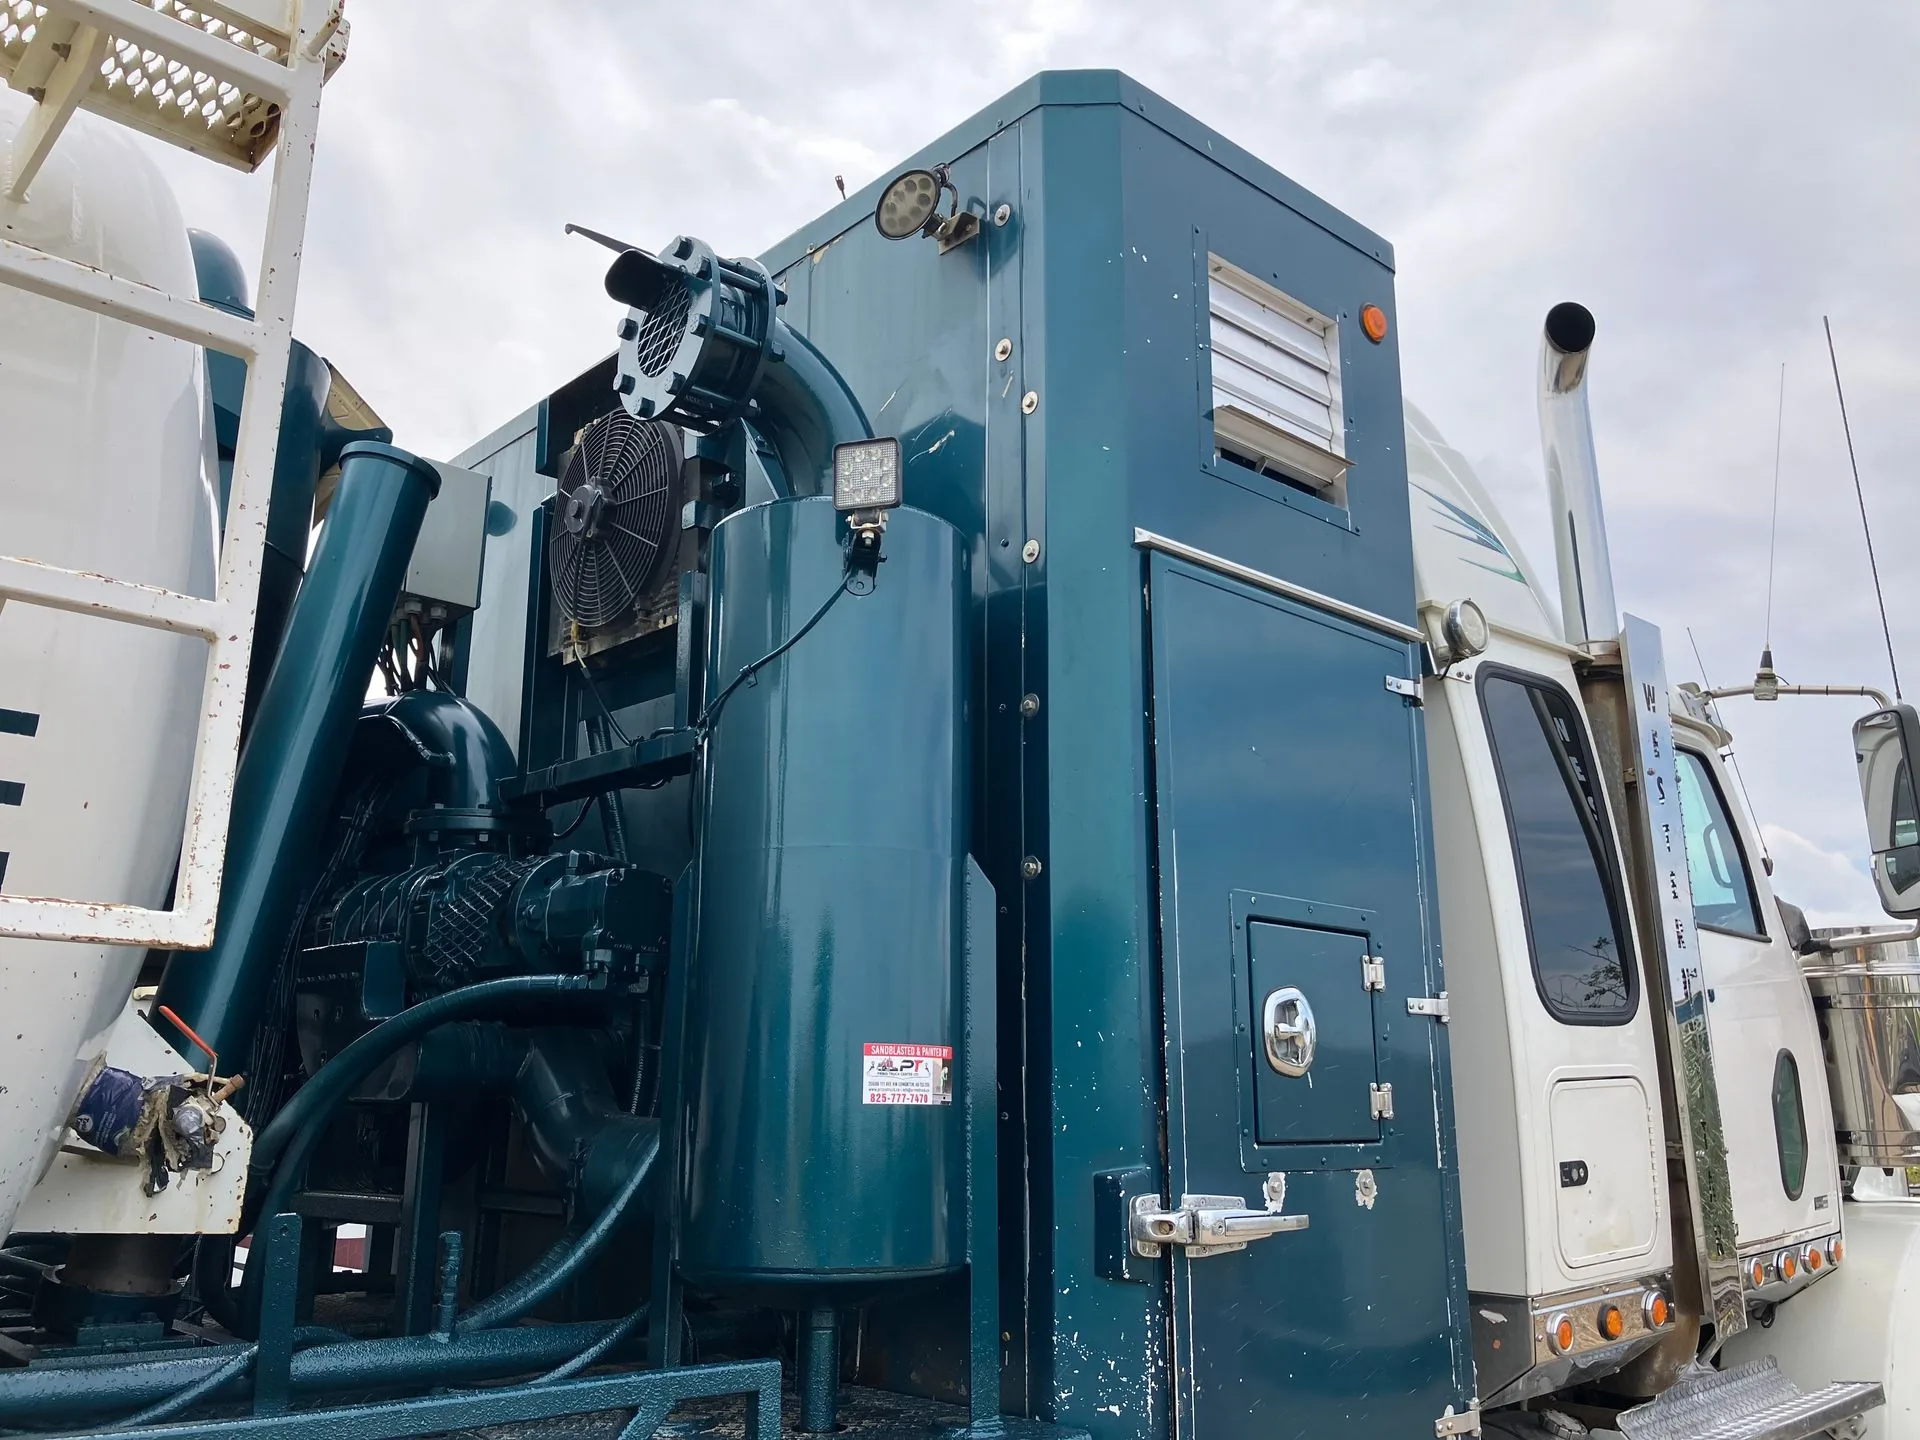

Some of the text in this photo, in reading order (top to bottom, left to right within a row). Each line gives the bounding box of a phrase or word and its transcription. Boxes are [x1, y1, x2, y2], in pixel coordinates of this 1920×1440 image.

[871, 1045, 948, 1058] SANDBLASTED & PAINTED BY
